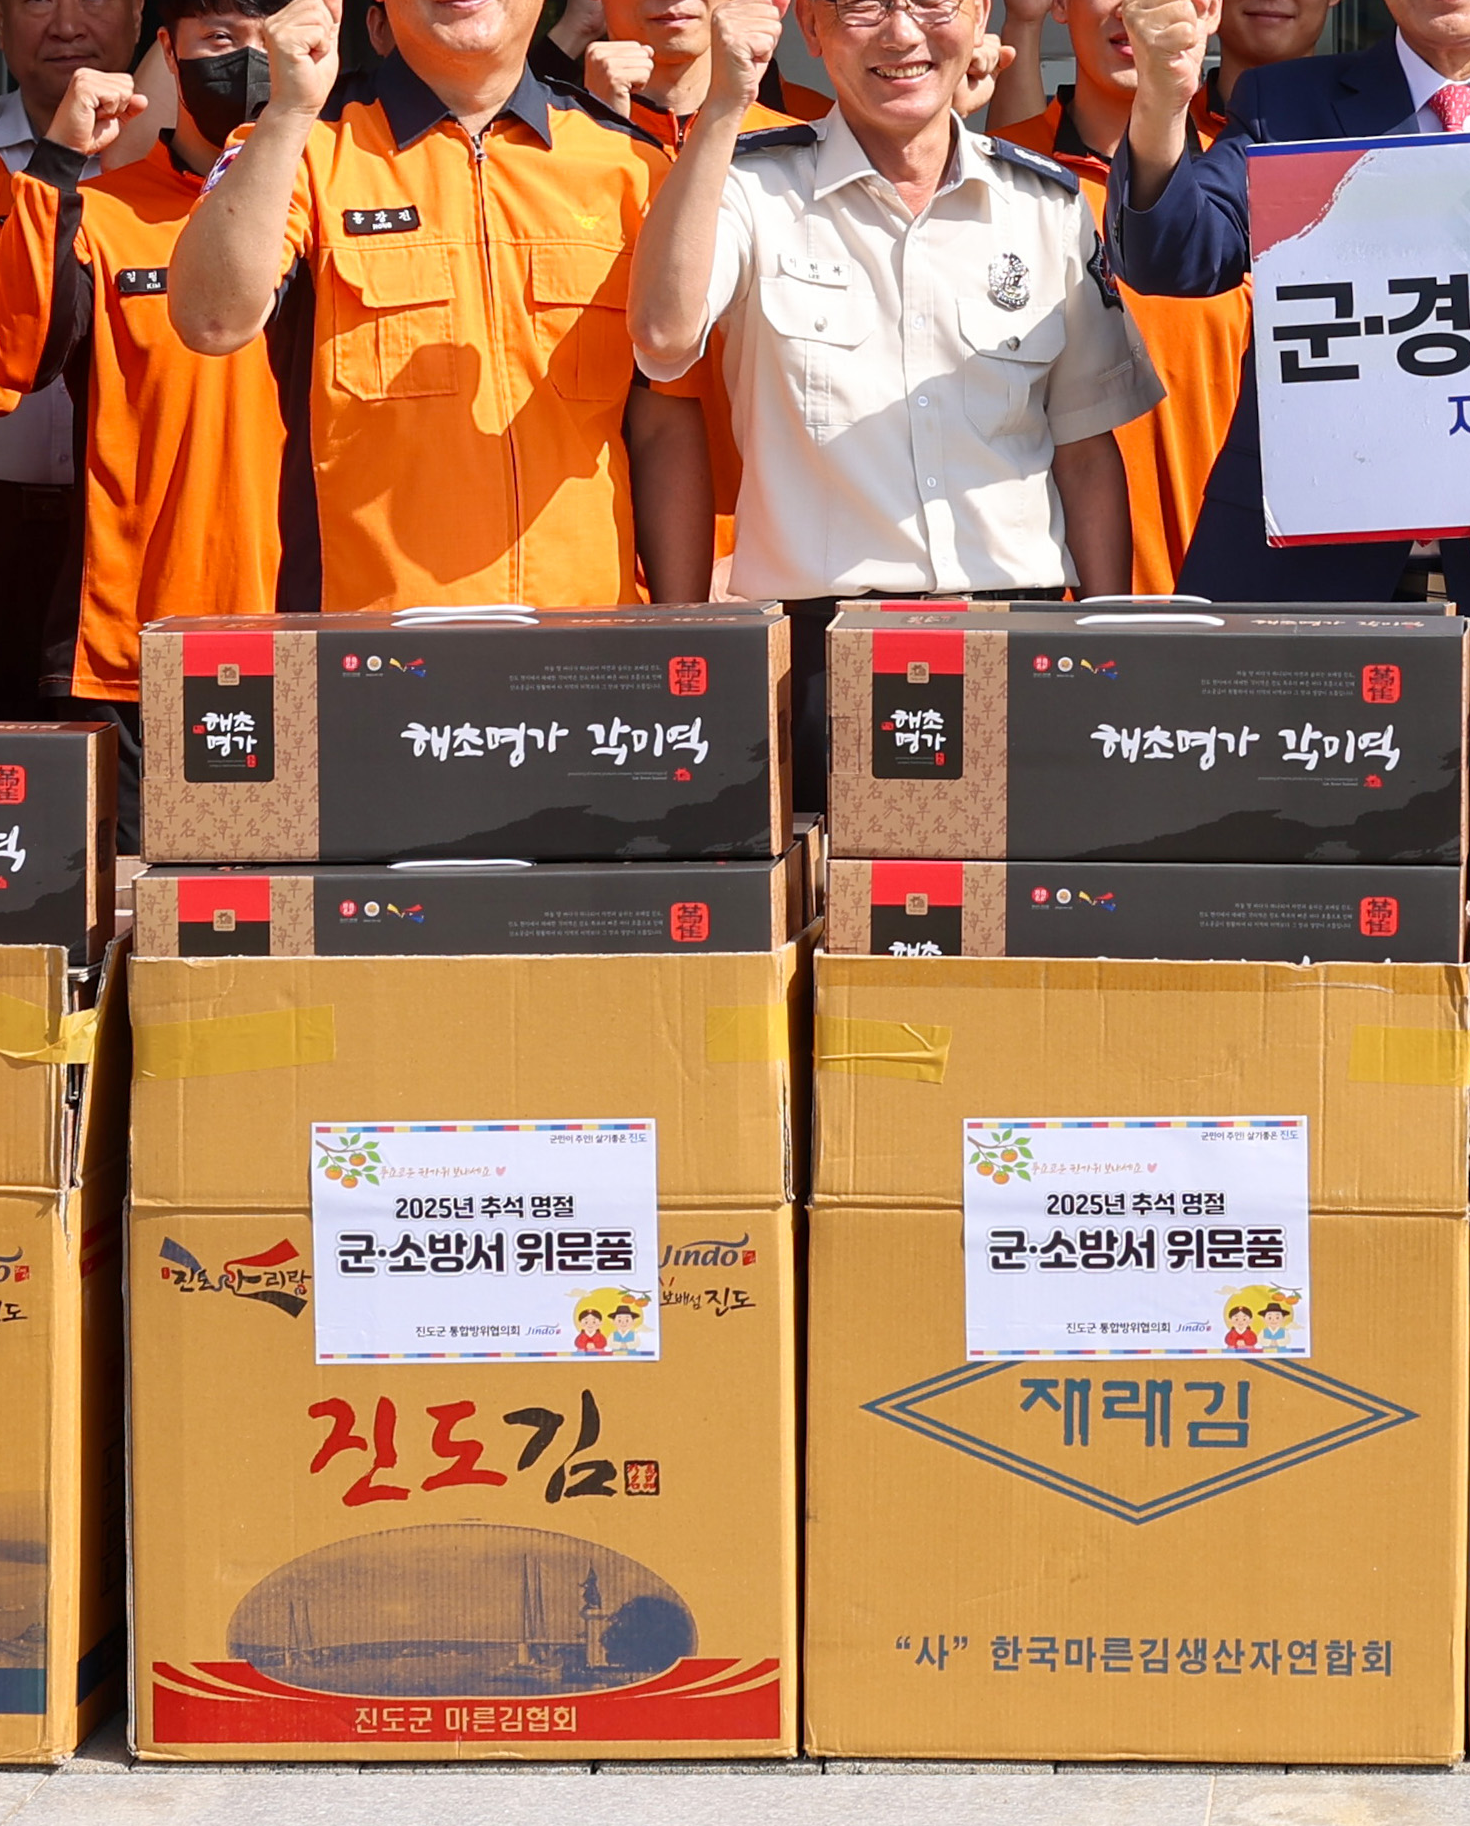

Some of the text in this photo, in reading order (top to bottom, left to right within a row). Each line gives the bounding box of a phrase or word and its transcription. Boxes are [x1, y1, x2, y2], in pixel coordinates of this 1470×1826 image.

[201, 710, 255, 733] 해초
[890, 709, 944, 730] 해초
[206, 731, 258, 757] 명가
[400, 714, 709, 771] 해초명가 각미역
[895, 730, 947, 754] 명가
[1090, 722, 1400, 771] 해초명가 각미역
[1280, 1130, 1299, 1140] 진도
[395, 1196, 574, 1219] 2025년 추석 명절
[1047, 1193, 1225, 1215] 2025년 추석 명절
[338, 1231, 633, 1273] 군·소방서 위문품
[990, 1229, 1284, 1269] 군·소방서 위문품
[660, 1286, 756, 1312] 보배섬 진도
[415, 1325, 446, 1338] 진도군
[449, 1324, 520, 1337] 통합방위협의회
[1066, 1322, 1096, 1334] 진도군
[1099, 1321, 1170, 1334] 통합방위협의회
[1019, 1378, 1251, 1449] 재래김
[308, 1389, 619, 1507] 진도김
[989, 1634, 1394, 1677] 한국마른김생산자연합회
[354, 1704, 578, 1733] 진도군 마른김협회
